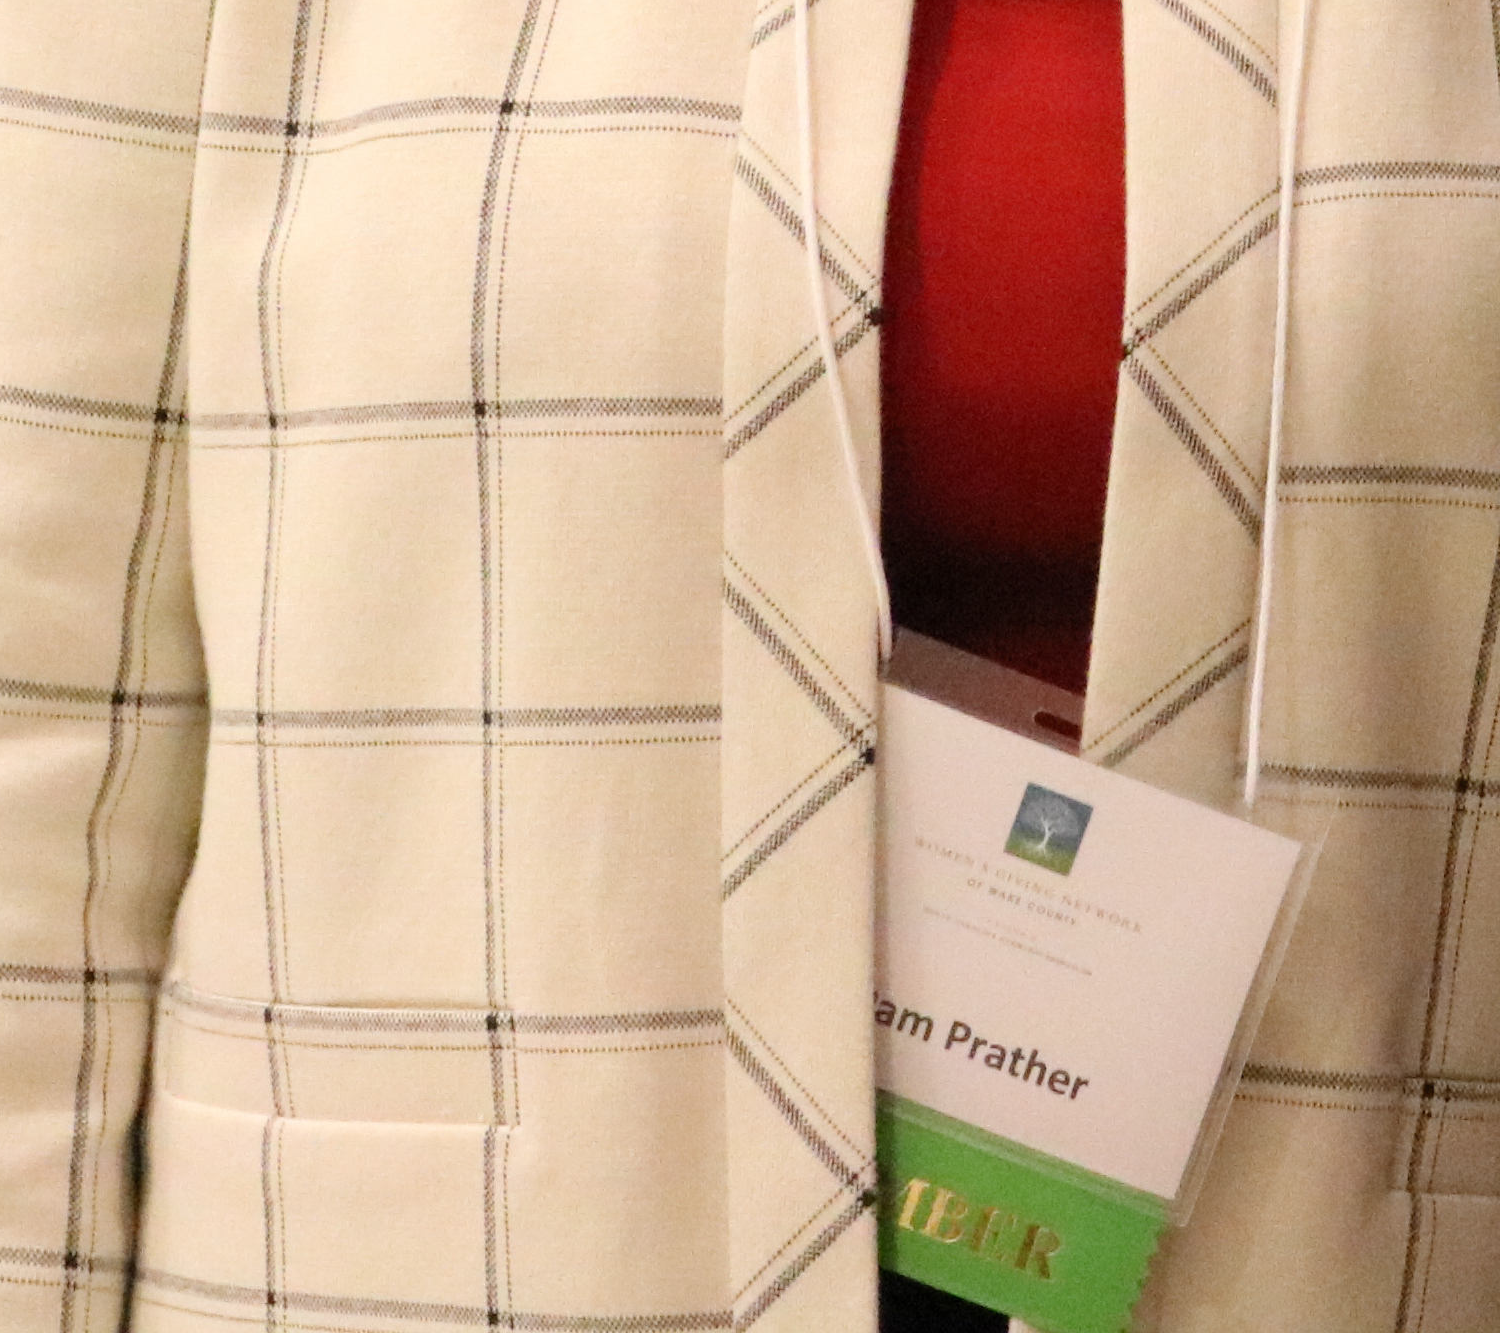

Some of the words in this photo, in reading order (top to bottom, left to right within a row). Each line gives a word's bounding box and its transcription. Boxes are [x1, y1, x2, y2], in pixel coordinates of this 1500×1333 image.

[966, 877, 983, 889] OF
[989, 886, 1022, 906] WAKE
[995, 868, 1056, 900] GIVING
[1062, 894, 1142, 933] NETWORK
[873, 989, 934, 1042] am
[944, 1019, 1090, 1101] Prather
